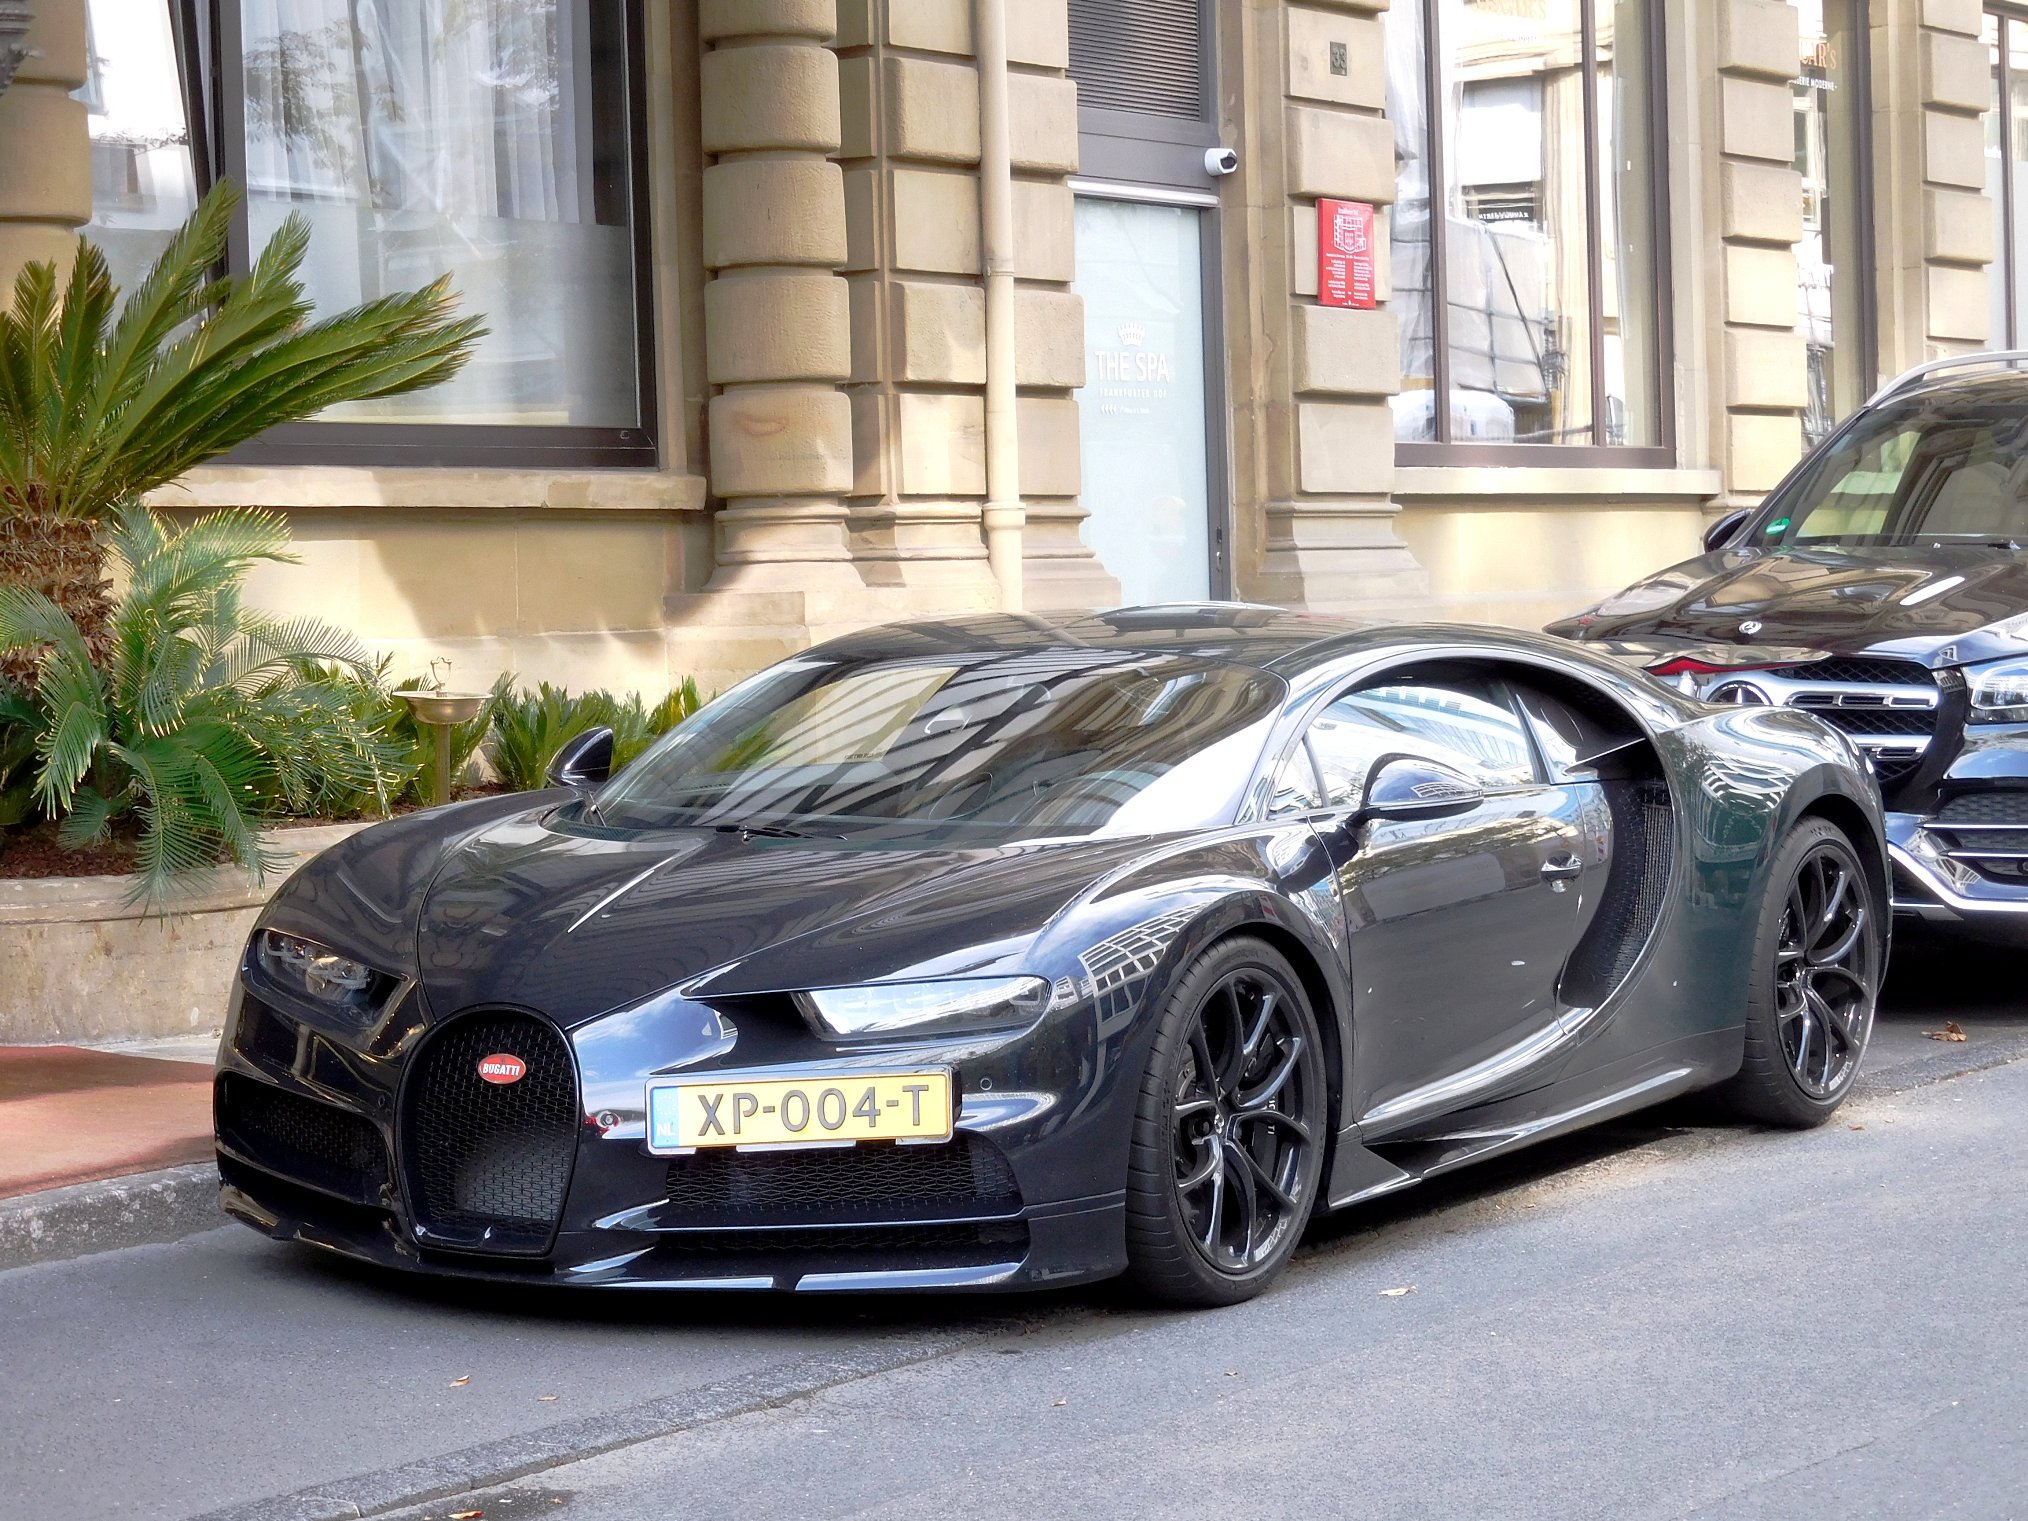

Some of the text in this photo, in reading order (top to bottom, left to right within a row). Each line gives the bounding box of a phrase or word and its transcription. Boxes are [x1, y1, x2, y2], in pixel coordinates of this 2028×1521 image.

[1095, 350, 1170, 384] THE SPA
[1099, 387, 1167, 399] FRANKFURTER HOF
[482, 1063, 520, 1076] BUGATTI
[697, 1084, 930, 1136] XP-004-T
[656, 1121, 676, 1137] NL
